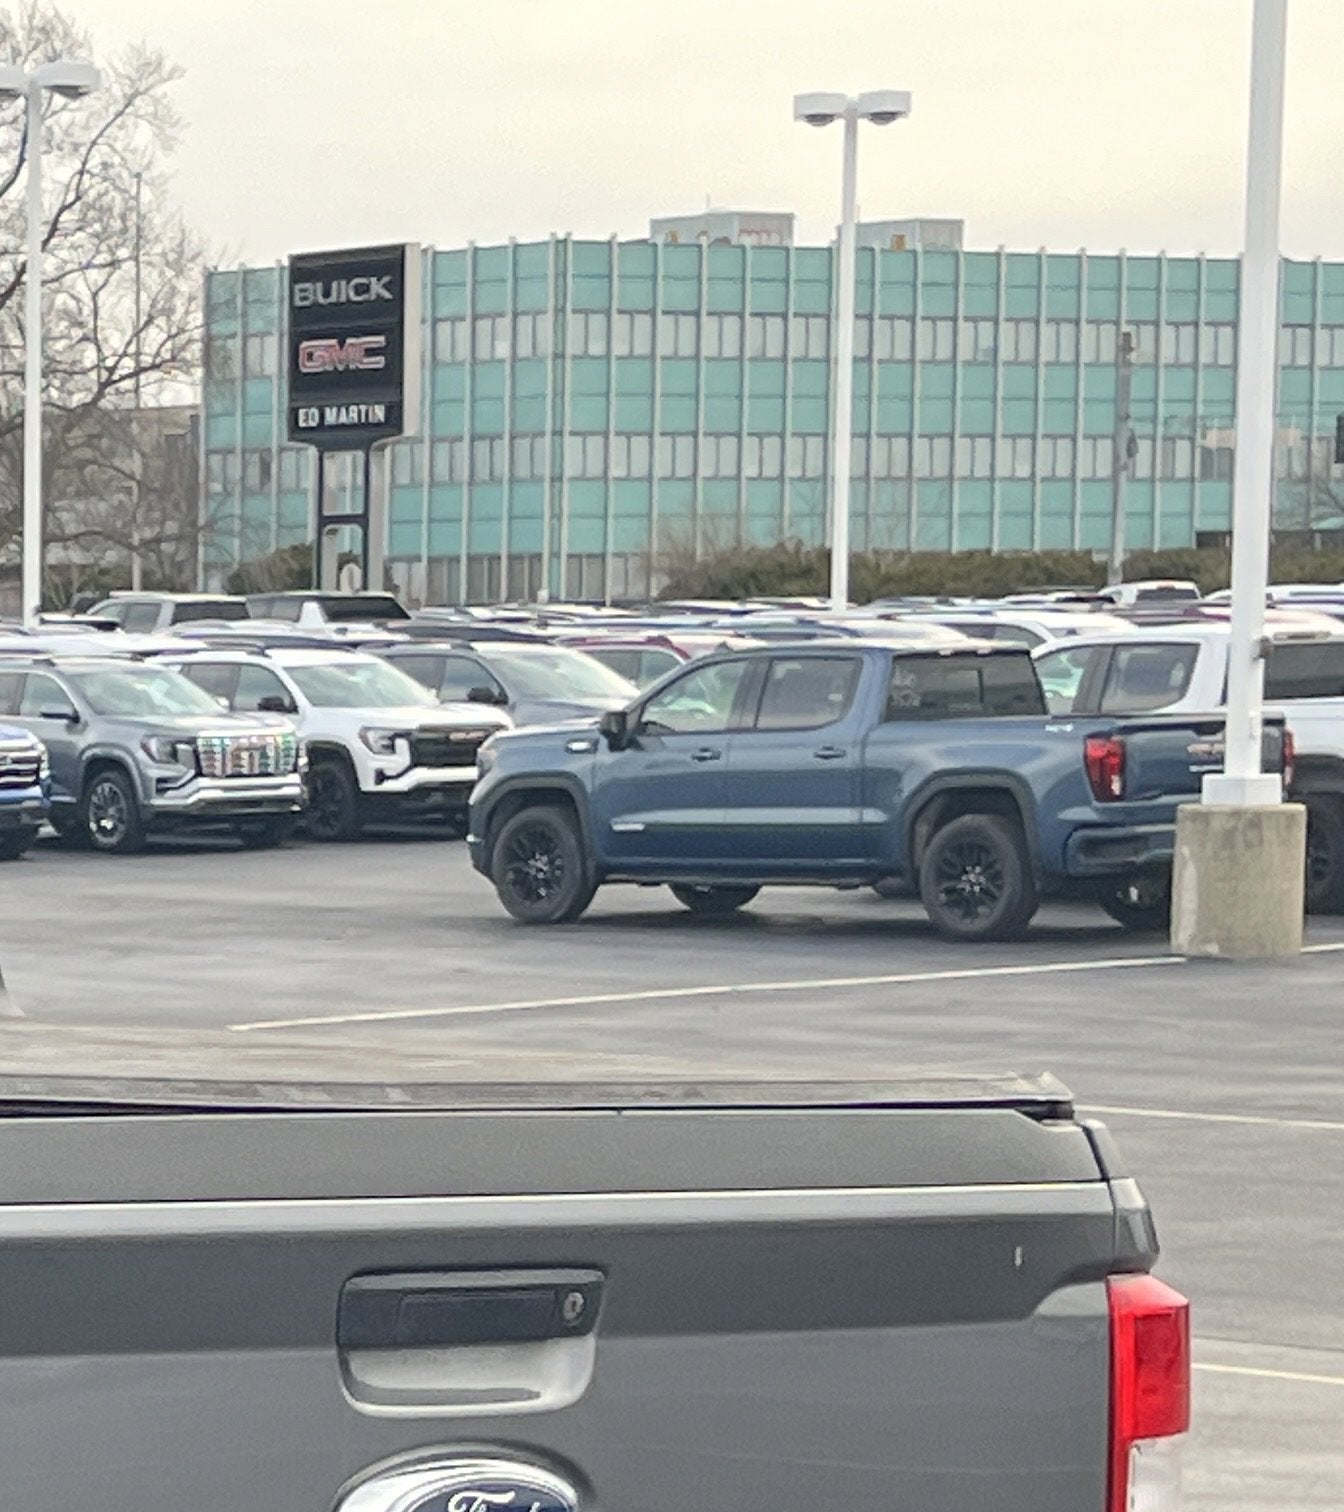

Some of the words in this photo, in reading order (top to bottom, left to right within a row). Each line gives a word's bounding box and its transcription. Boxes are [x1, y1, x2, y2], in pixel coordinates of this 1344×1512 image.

[293, 275, 393, 307] BUICK
[298, 334, 385, 373] GMC
[297, 408, 319, 428] ED
[324, 404, 385, 426] MARTIN
